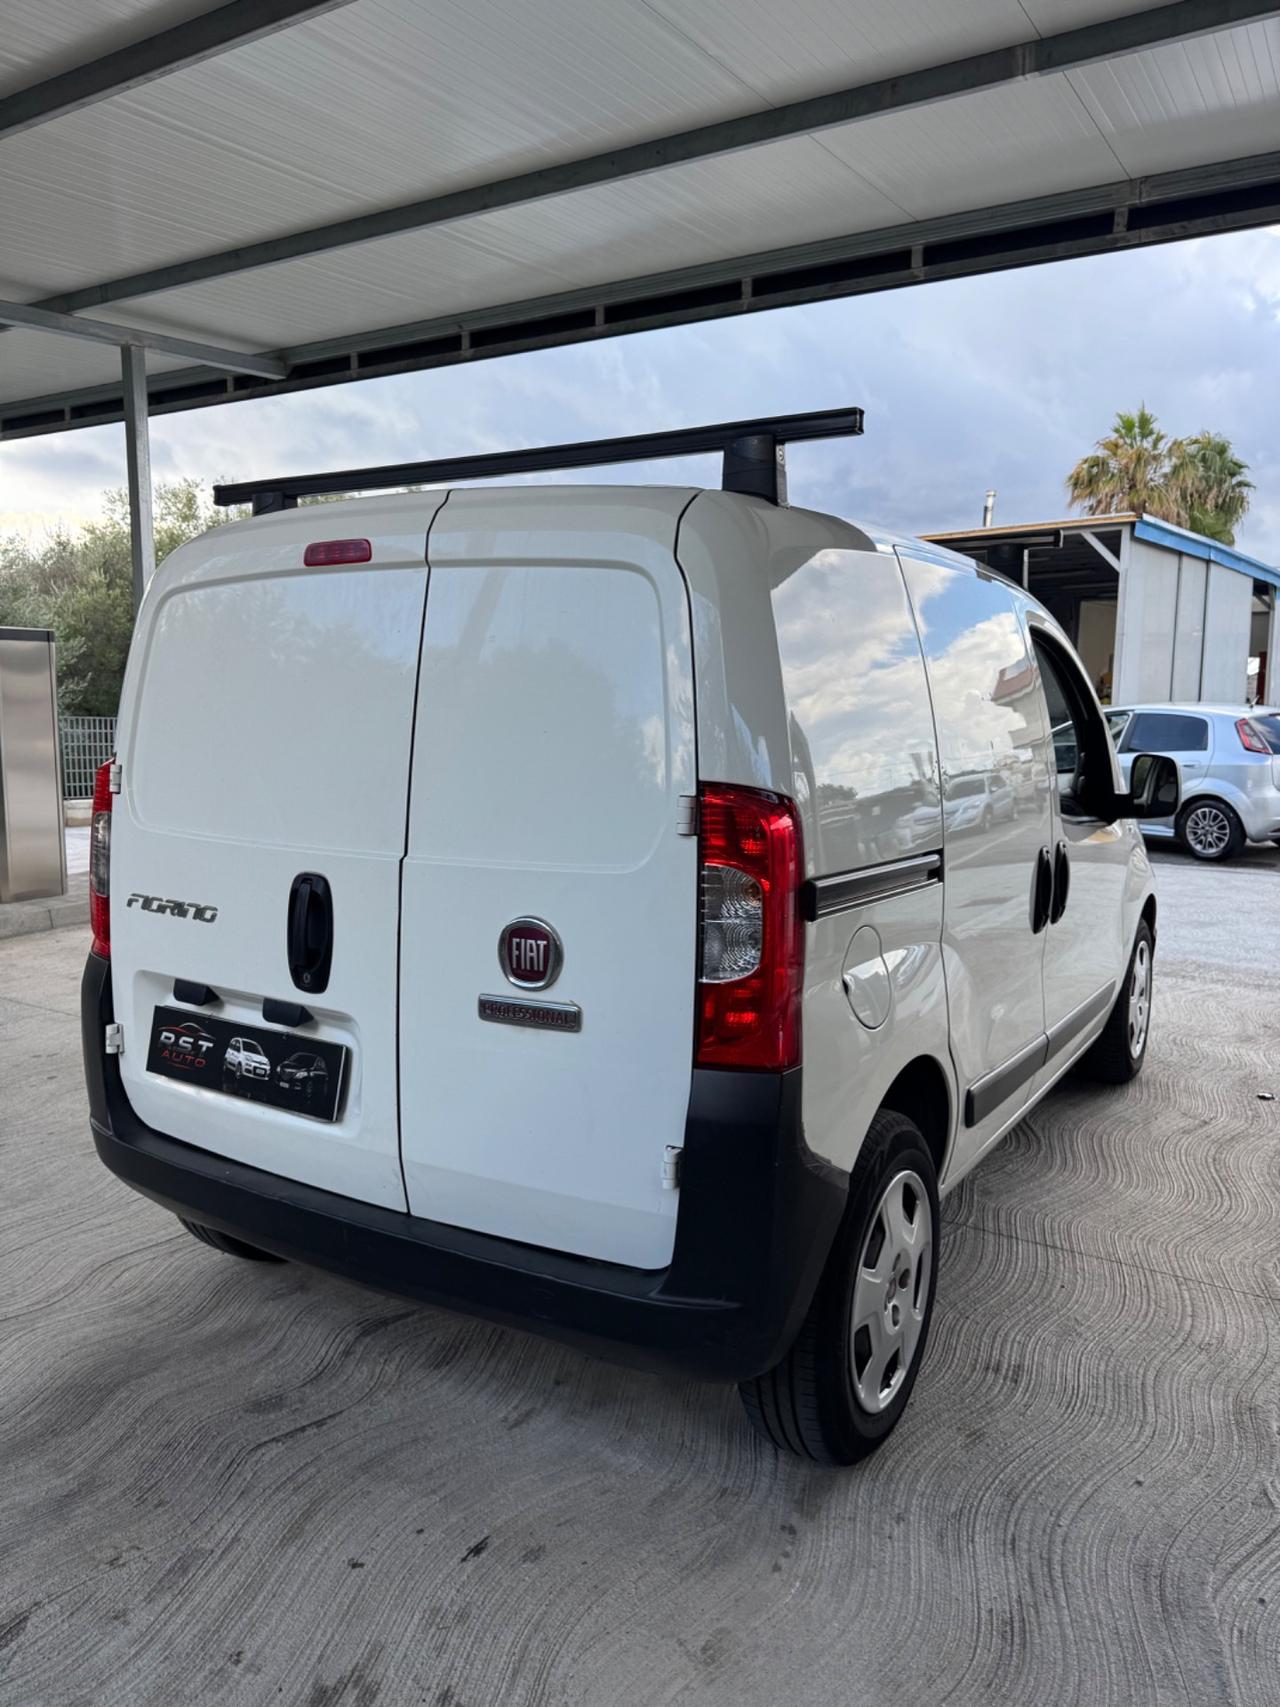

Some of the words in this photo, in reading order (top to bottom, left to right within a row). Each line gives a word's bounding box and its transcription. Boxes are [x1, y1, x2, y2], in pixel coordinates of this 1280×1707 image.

[126, 892, 219, 924] FIORINO
[511, 937, 548, 972] FIAT
[161, 1048, 206, 1068] AUTO
